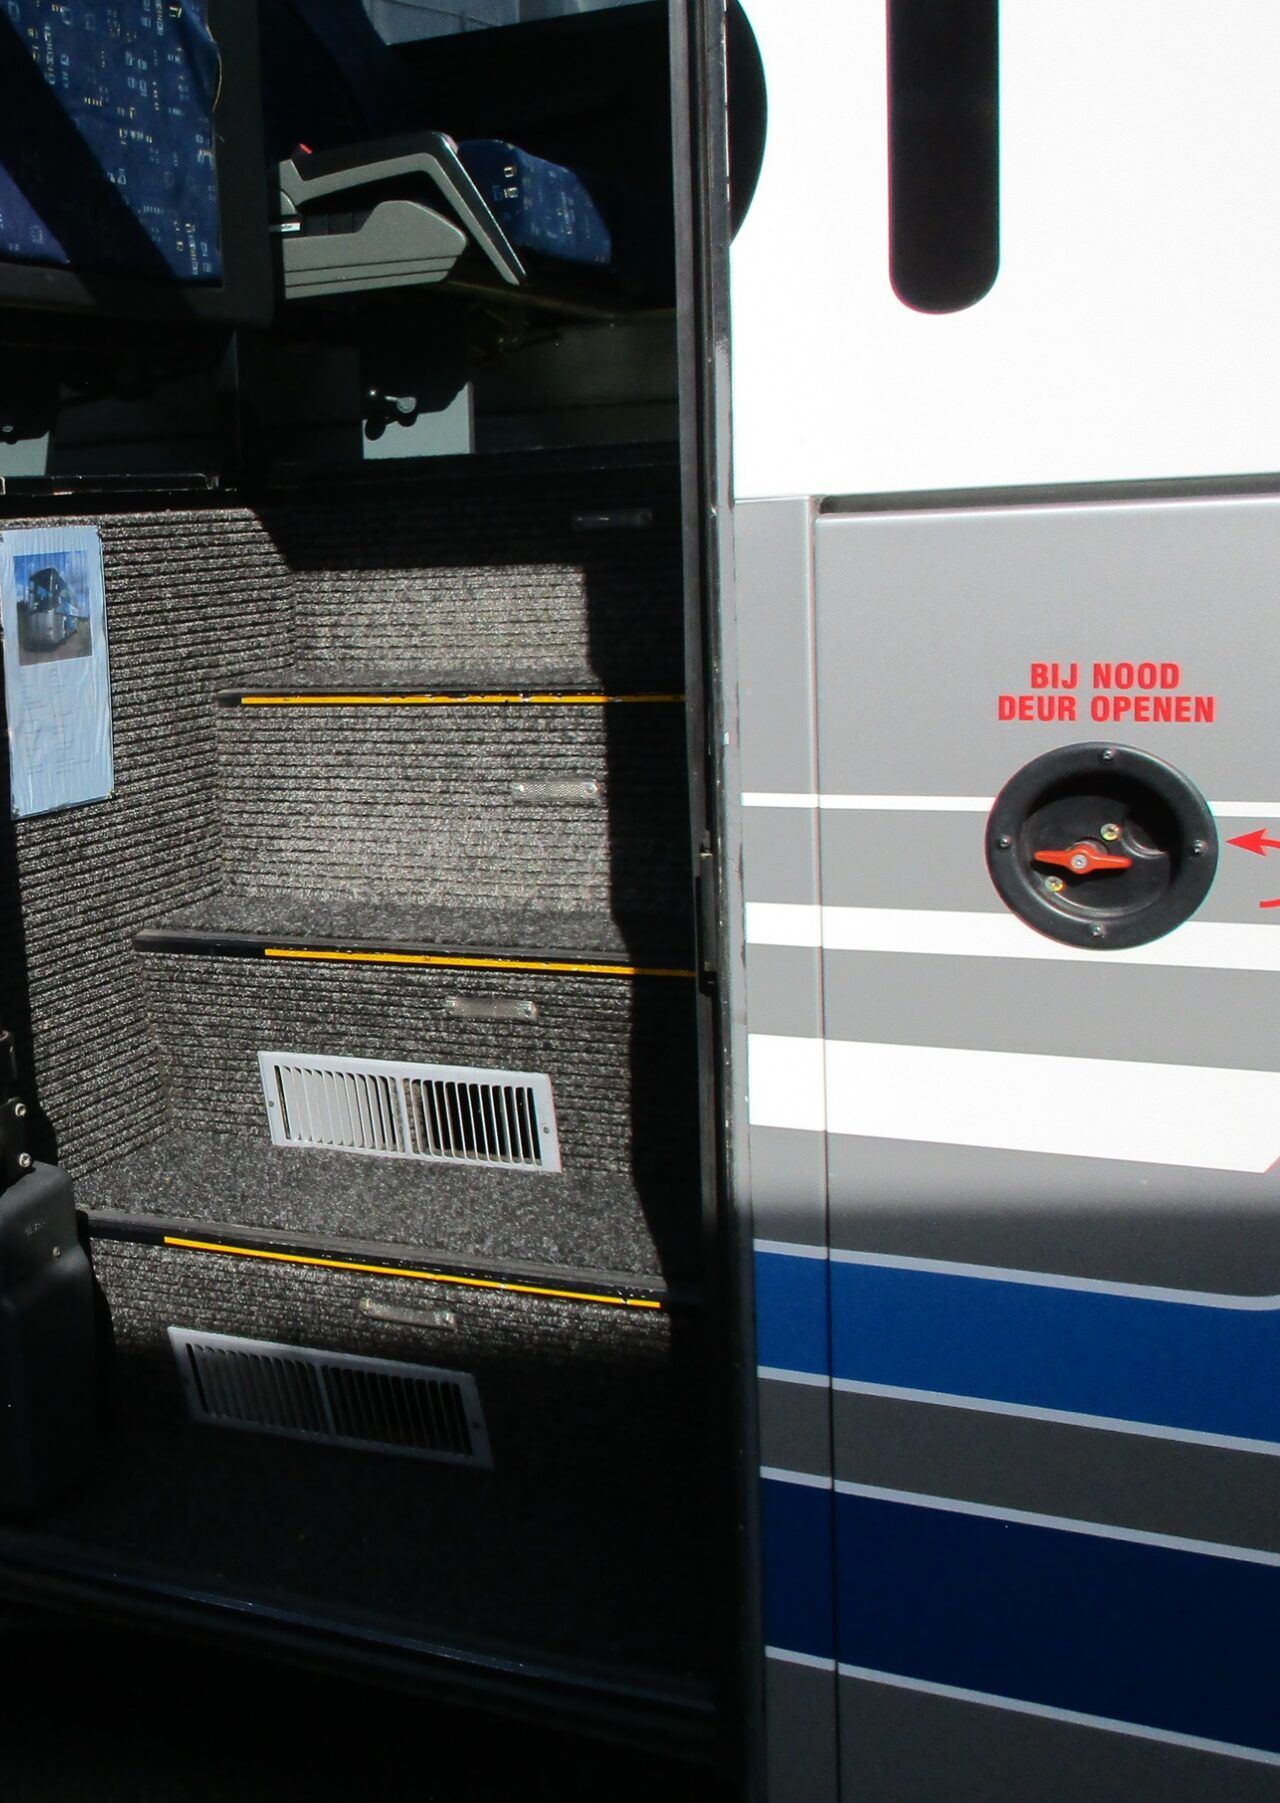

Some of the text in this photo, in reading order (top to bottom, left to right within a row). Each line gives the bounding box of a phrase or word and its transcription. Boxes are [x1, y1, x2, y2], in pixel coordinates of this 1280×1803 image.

[1030, 662, 1181, 690] BIJ NOOD
[998, 694, 1215, 723] DEUR OPENEN
